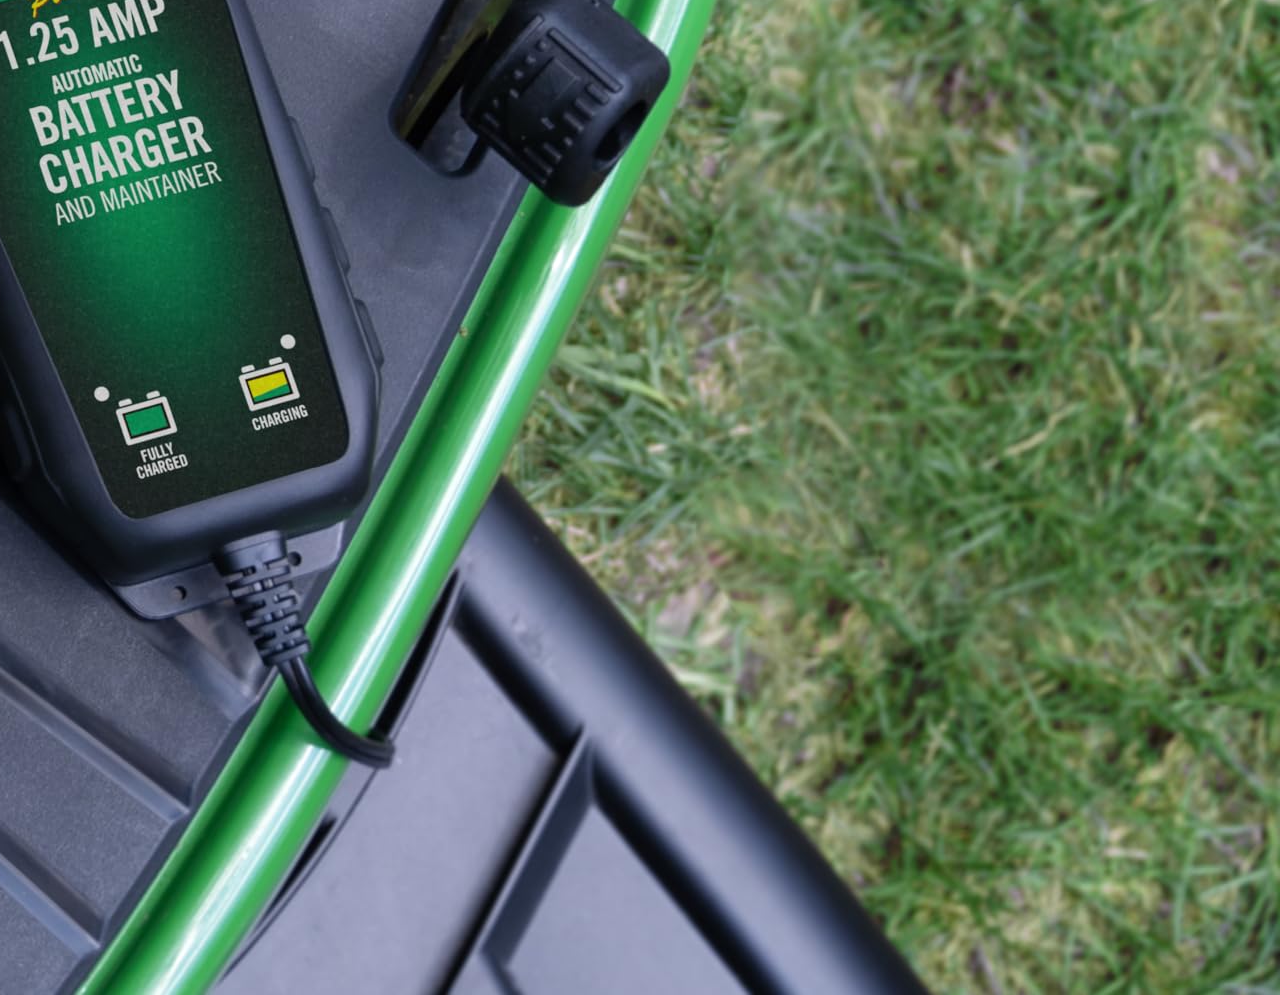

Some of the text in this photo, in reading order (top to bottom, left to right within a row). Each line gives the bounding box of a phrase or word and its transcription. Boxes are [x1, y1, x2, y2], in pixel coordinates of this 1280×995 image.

[51, 54, 142, 94] AUTOMATIC
[29, 70, 183, 147] BATTERY
[39, 116, 212, 194] CHARGER
[55, 161, 222, 226] AND MAINTAINER
[252, 404, 308, 431] CHARGING
[136, 454, 188, 480] CHARGED
[140, 442, 175, 463] FULLY
